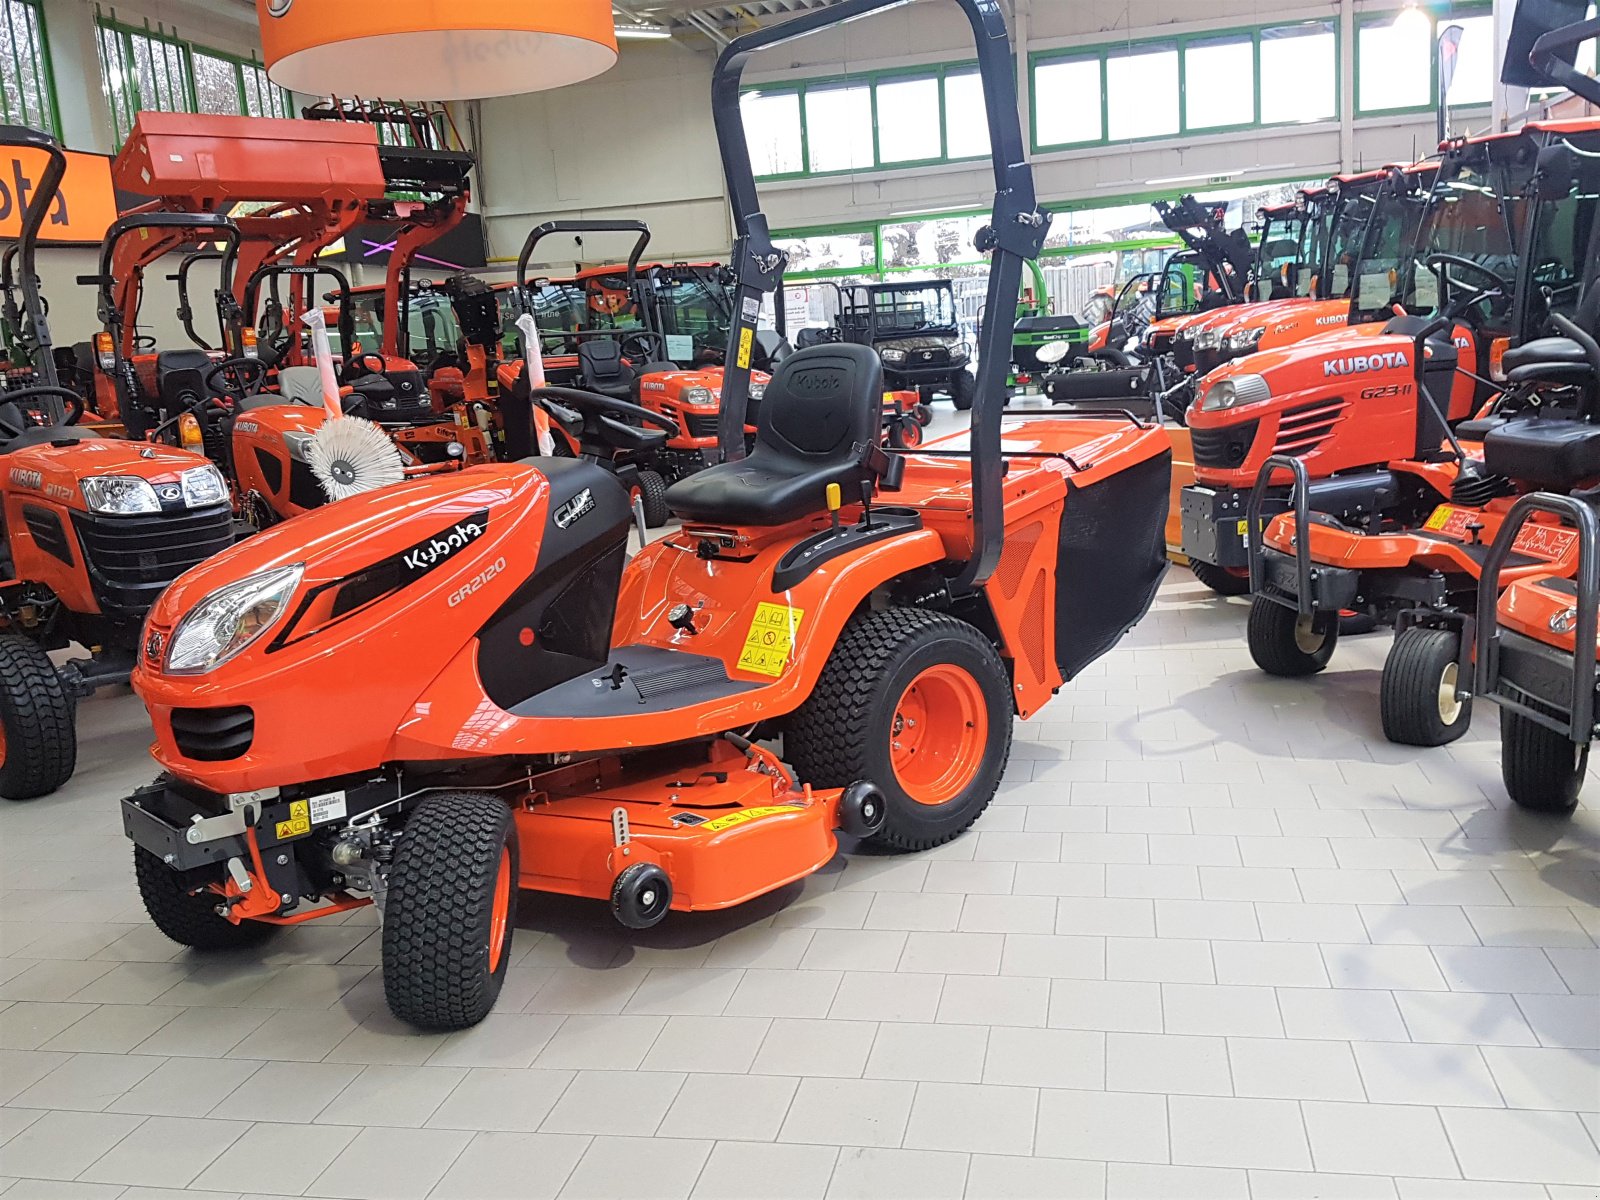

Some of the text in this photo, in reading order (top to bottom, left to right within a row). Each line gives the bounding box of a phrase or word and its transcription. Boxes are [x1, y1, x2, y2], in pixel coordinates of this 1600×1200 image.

[1323, 351, 1409, 377] KUBOTA
[642, 381, 665, 391] KUBOTA
[234, 421, 258, 433] KUBOTA
[9, 467, 43, 491] KUBOTA
[571, 500, 596, 521] STEER
[403, 523, 483, 570] Kubota
[447, 556, 508, 608] GR2120
